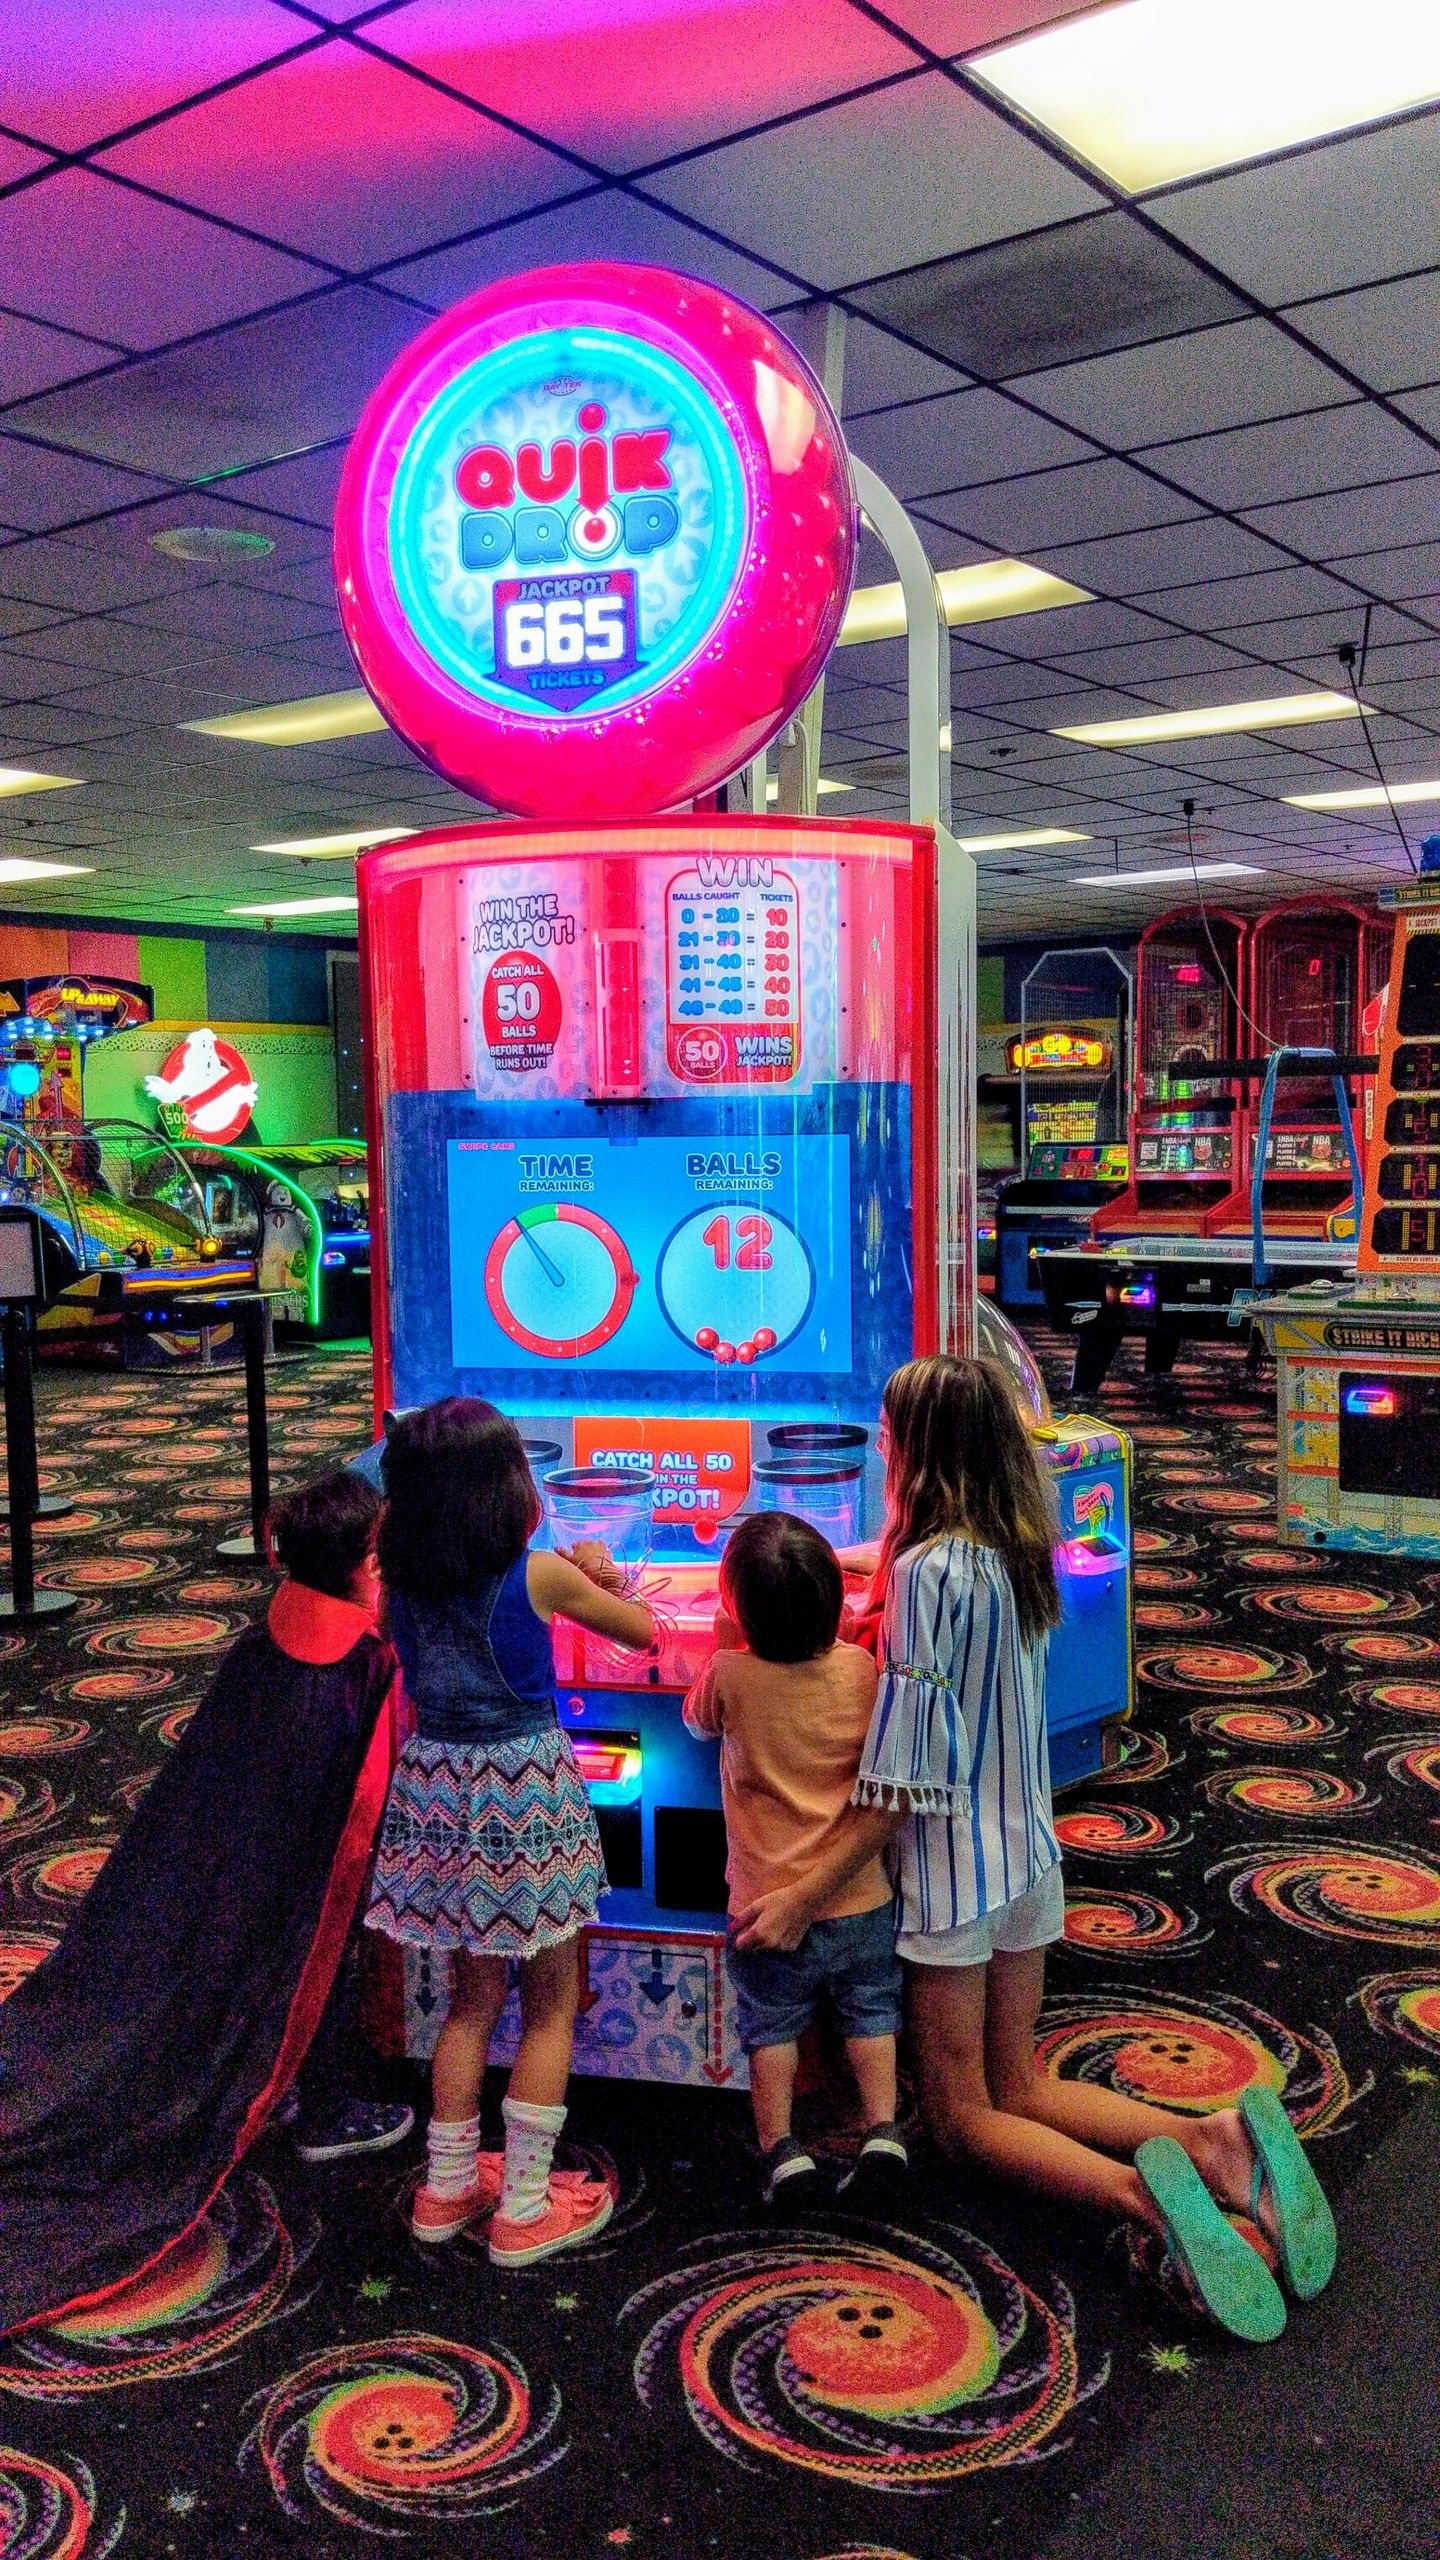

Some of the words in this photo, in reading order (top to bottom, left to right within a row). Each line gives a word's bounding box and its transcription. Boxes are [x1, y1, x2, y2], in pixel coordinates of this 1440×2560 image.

[462, 495, 679, 569] DROP
[518, 575, 610, 600] JACKPOT
[505, 596, 626, 667] 665
[528, 670, 605, 690] TICKETS
[696, 858, 774, 888] WIN
[672, 892, 703, 901] BALLS
[704, 892, 741, 901] CAUGHT
[760, 893, 794, 902] TICKETS
[480, 898, 514, 924] WIN
[516, 894, 559, 920] THE
[681, 908, 695, 924] 0
[766, 908, 788, 926] 10
[473, 915, 575, 954] JACKPOT!
[678, 931, 700, 947] 21
[716, 930, 741, 946] 30
[764, 930, 789, 949] 20
[492, 965, 522, 979] CATCH
[523, 963, 545, 977] ALL
[679, 954, 700, 970] 31
[717, 953, 742, 969] 40
[764, 953, 789, 972] 30
[679, 977, 701, 993] 41
[764, 976, 790, 994] 40
[496, 981, 542, 1022] 50
[764, 999, 789, 1017] 50
[502, 1024, 537, 1038] BALLS
[490, 1044, 525, 1057] BEFORE
[526, 1042, 554, 1055] TIME
[685, 1040, 719, 1062] 50
[735, 1035, 794, 1055] WINS
[495, 1058, 521, 1070] RUNS
[522, 1056, 548, 1069] OUT!
[690, 1061, 716, 1069] BALLS
[736, 1055, 793, 1067] JACKPOT!
[165, 1112, 189, 1125] 500
[1195, 1137, 1211, 1147] NBA
[1313, 1135, 1331, 1145] NBA
[519, 1154, 594, 1178] TIME
[687, 1152, 782, 1177] BALLS
[519, 1181, 595, 1192] REMAINING:
[695, 1178, 774, 1191] REMAINING:
[703, 1215, 774, 1271] 12
[1332, 1327, 1385, 1347] STRIKE
[1387, 1330, 1402, 1348] IT
[591, 1450, 655, 1469] CATCH
[659, 1452, 700, 1471] ALL
[704, 1453, 734, 1472] 50
[671, 1474, 698, 1486] THE
[651, 1488, 720, 1510] KPOT!
